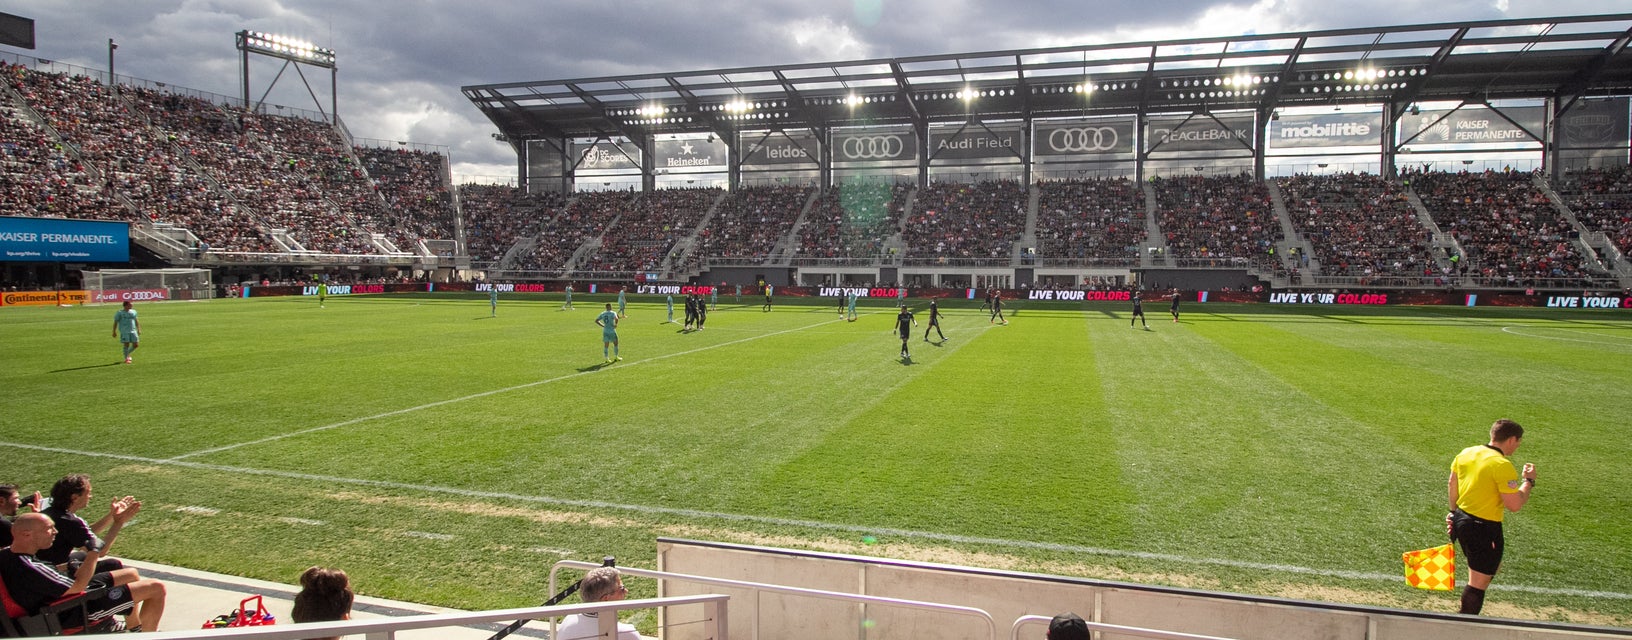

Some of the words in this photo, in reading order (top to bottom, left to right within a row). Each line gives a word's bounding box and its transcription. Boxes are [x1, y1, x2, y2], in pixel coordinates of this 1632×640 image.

[1456, 120, 1489, 129] KAISER
[1281, 122, 1370, 138] mobilitie
[1455, 130, 1522, 140] PERMANENTE
[938, 138, 973, 150] Audi
[976, 137, 1012, 149] Field
[766, 145, 807, 159] leidos
[667, 157, 709, 167] Heineken
[0, 232, 37, 242] KAISER
[41, 233, 114, 244] PERMANENTE
[303, 286, 319, 295] LIV
[326, 285, 351, 294] YOUR
[352, 285, 384, 294] COLORS
[475, 283, 492, 292] LIVE
[514, 283, 545, 292] COLORS
[657, 285, 680, 294] YOUR
[681, 285, 713, 295] COLORS
[820, 287, 842, 297] LIVE
[5, 294, 58, 304] Continental
[1029, 290, 1053, 300] LIVE
[1055, 290, 1085, 300] YOUR
[1087, 290, 1130, 301] COLORS
[1269, 293, 1298, 303] LIVE
[1337, 294, 1387, 305] COLORS
[1547, 296, 1579, 307] LIVE
[1582, 296, 1620, 308] YOUR
